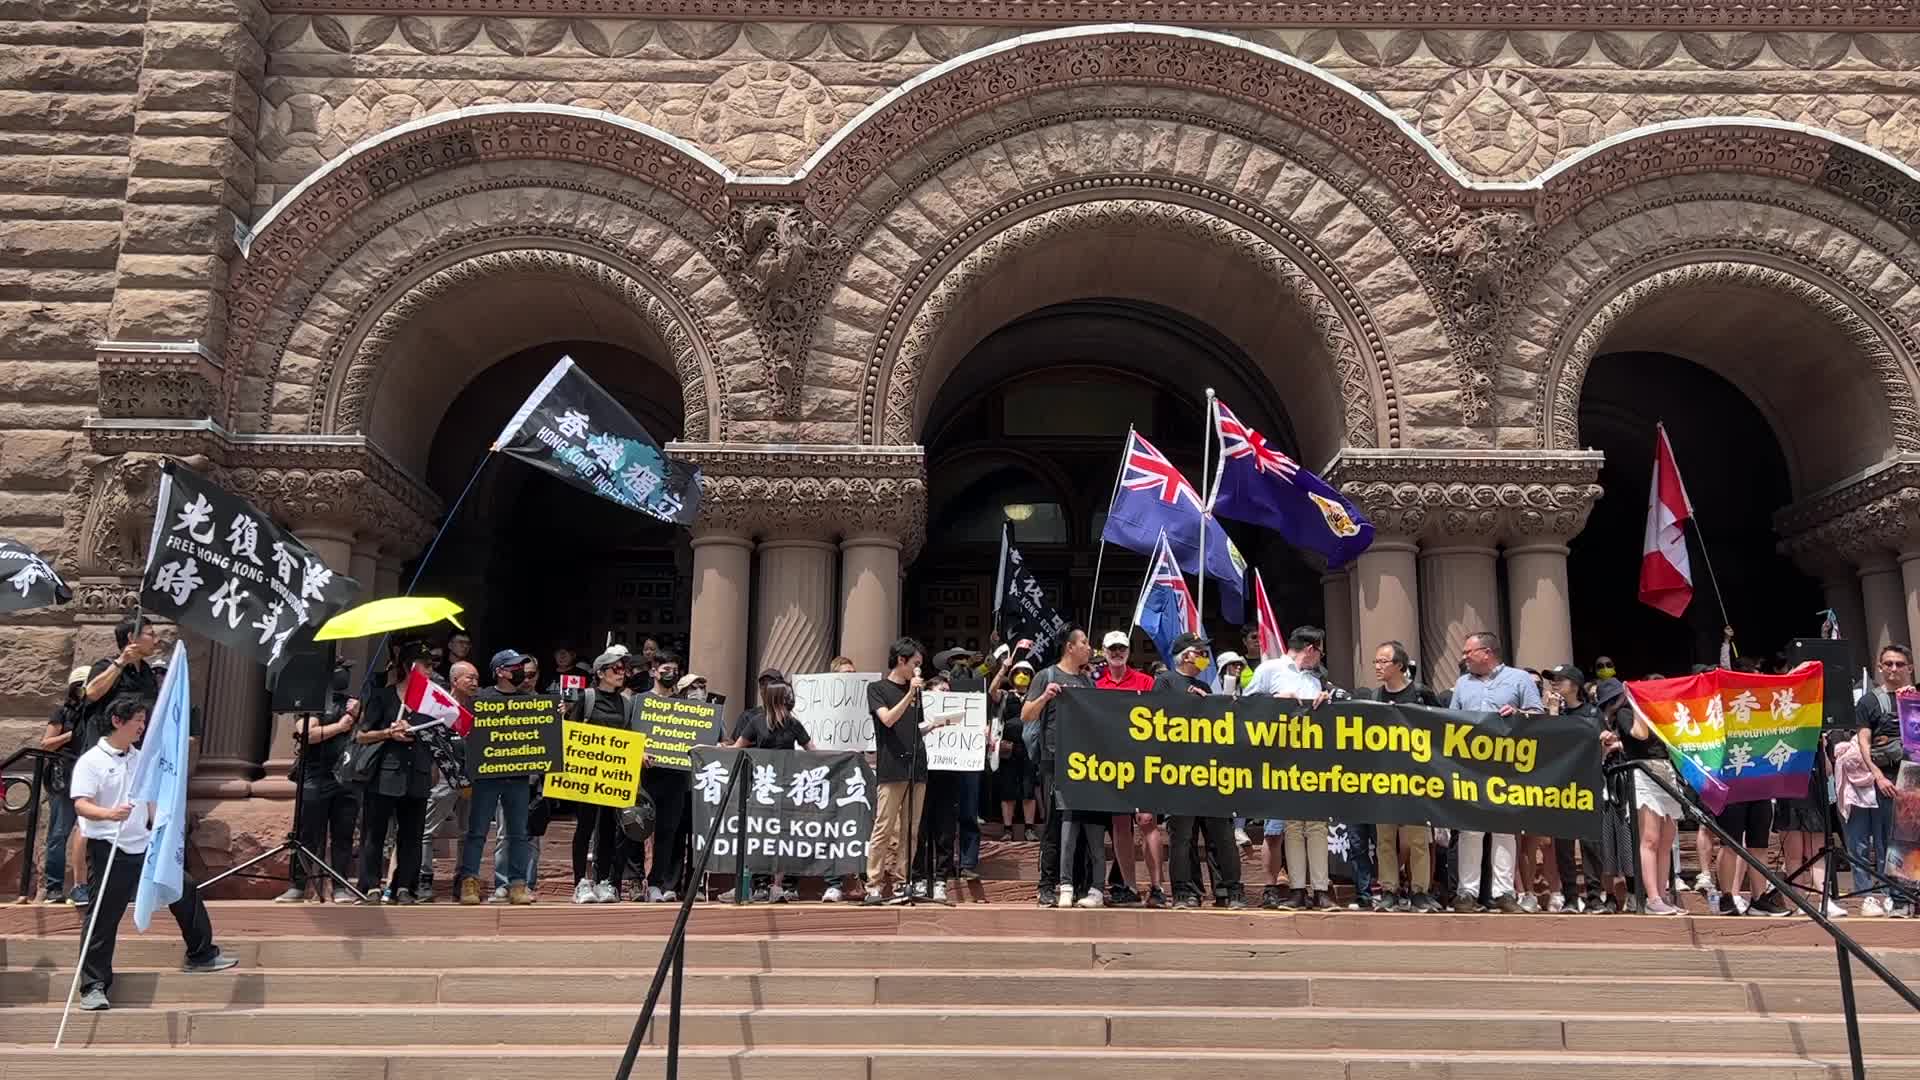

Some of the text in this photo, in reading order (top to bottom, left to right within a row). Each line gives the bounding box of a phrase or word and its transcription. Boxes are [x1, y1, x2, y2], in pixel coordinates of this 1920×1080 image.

[536, 425, 569, 453] HONG
[165, 535, 196, 554] FREE
[196, 545, 230, 569] HONG
[231, 561, 264, 583] KONG
[474, 698, 553, 713] Stop foreign
[643, 698, 715, 717] Stop foreign
[474, 715, 554, 727] interference
[490, 730, 539, 742] Protect
[569, 730, 630, 749] Fight for
[652, 725, 697, 740] Protect
[1128, 706, 1538, 773] Stand with Hong Kong
[484, 744, 546, 757] Canadian
[566, 745, 626, 765] freedom
[644, 738, 692, 753] Canadia
[478, 760, 552, 773] democracy
[564, 761, 633, 782] tand with
[551, 775, 631, 801] Hong Kong
[1067, 751, 1594, 811] Stop Foreign Interference in Canada
[790, 819, 857, 838] KONG
